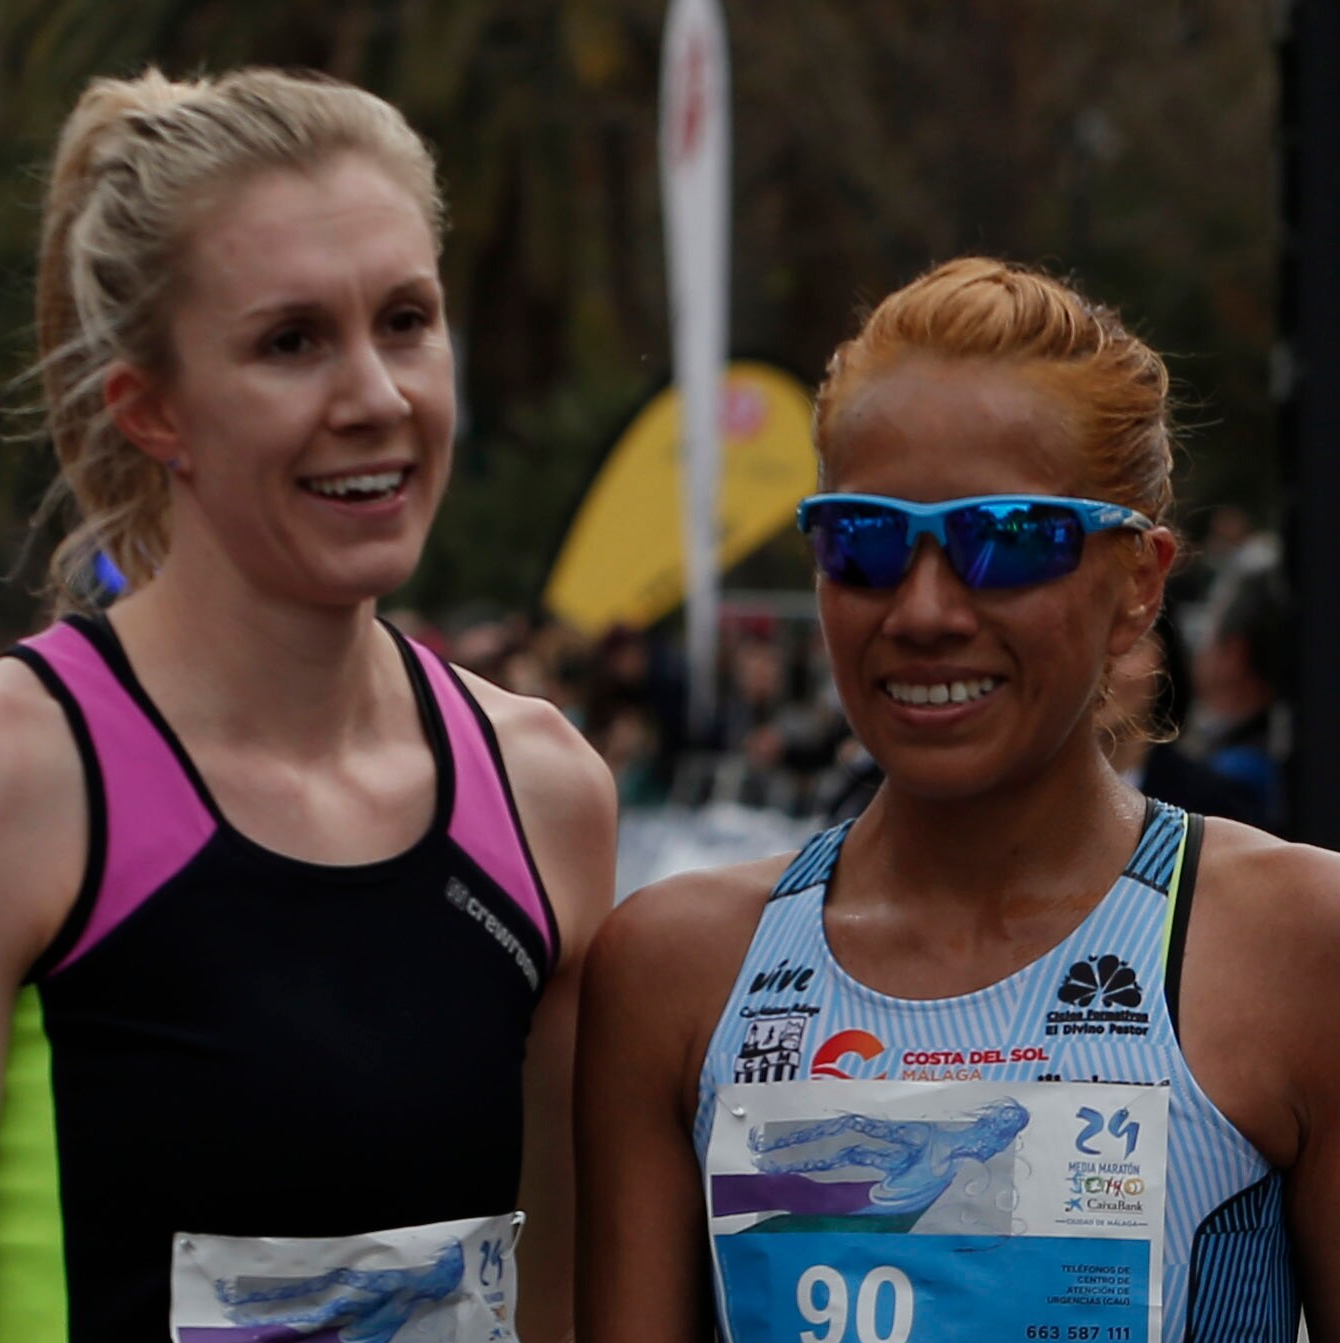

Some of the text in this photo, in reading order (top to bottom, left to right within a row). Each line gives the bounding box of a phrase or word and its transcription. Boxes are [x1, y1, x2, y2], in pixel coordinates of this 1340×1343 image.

[1046, 1024, 1149, 1036] El Divino Pastor
[903, 1048, 1048, 1065] COSTA DEL SOL
[902, 1067, 982, 1081] MÁLAGA
[1068, 1161, 1139, 1175] MEDIA MARATÓN
[1087, 1198, 1143, 1212] CaixaBank
[1118, 1266, 1131, 1274] DE
[1117, 1287, 1130, 1295] DE
[1026, 1326, 1130, 1340] 663 587 111
